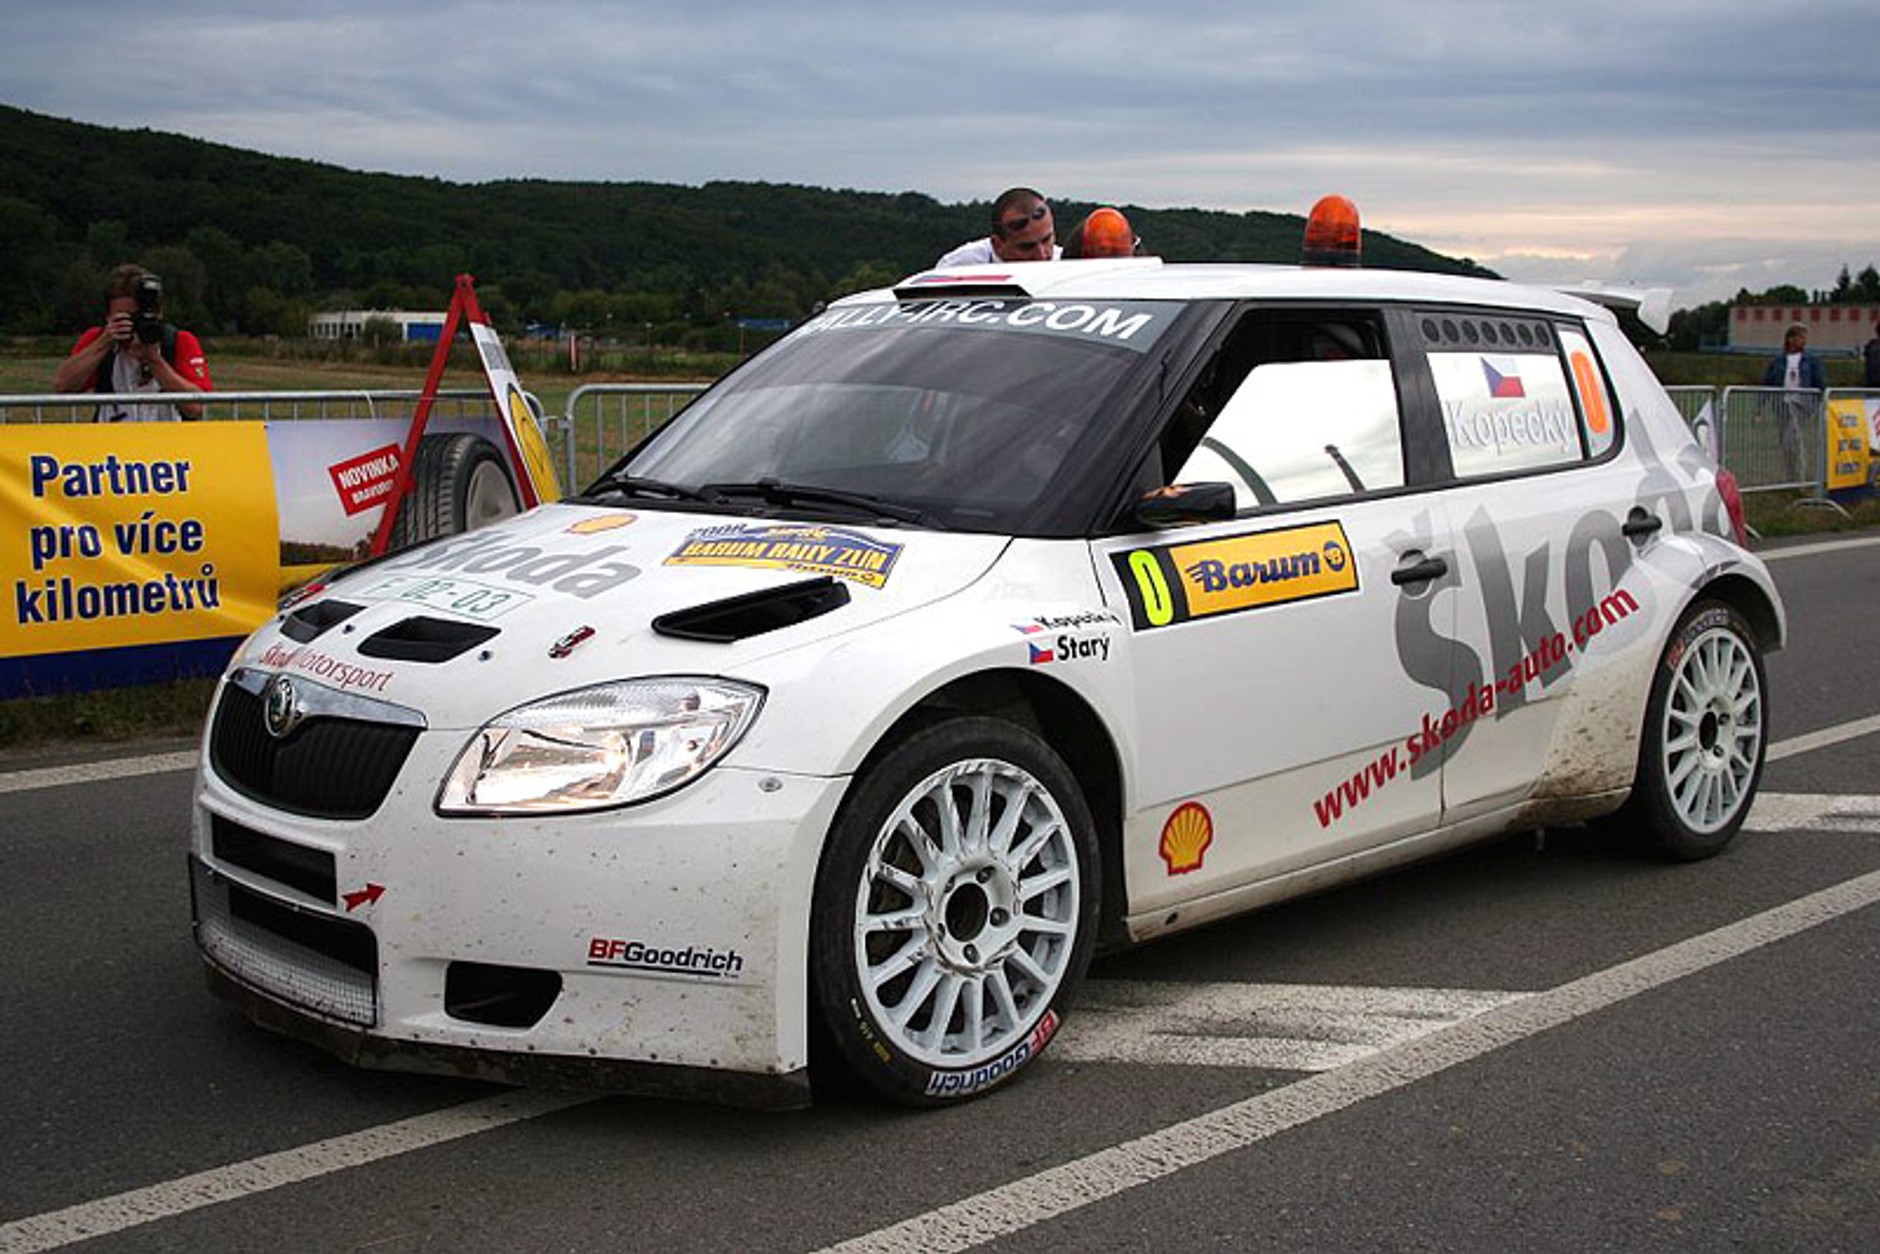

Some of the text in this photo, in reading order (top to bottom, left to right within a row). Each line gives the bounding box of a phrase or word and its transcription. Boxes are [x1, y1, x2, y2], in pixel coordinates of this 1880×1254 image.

[30, 455, 191, 498] Partner
[337, 453, 400, 490] NOVINKA
[30, 511, 204, 570] pro více
[766, 542, 838, 563] RALLY
[15, 564, 220, 624] kilometrů
[1127, 549, 1321, 627] 0 Barum
[1312, 587, 1640, 828] www.skoda-auto.com
[587, 937, 743, 972] BFGoodrich
